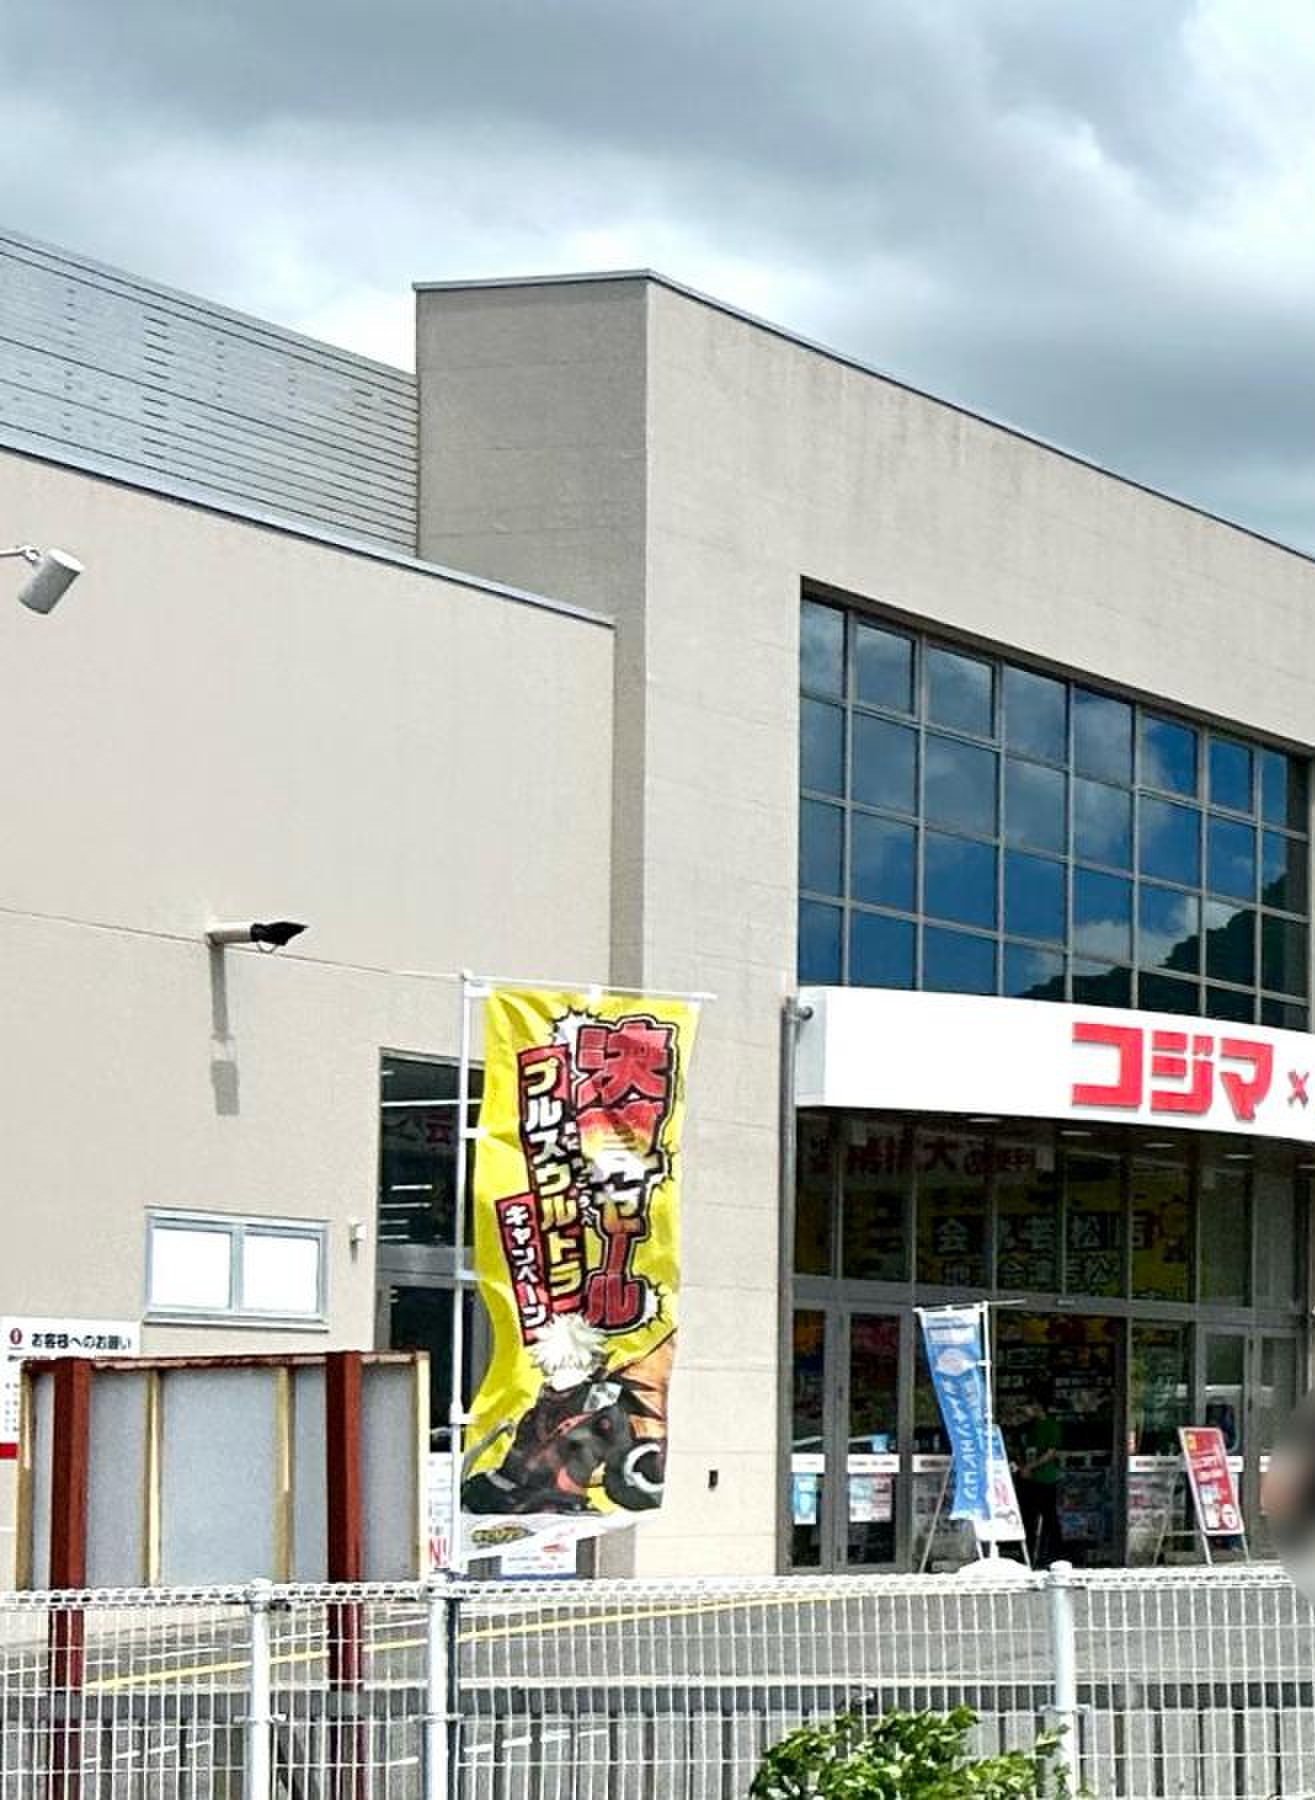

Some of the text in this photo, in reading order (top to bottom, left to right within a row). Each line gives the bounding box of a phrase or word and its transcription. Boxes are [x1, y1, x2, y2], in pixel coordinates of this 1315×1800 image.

[505, 1203, 548, 1328] キャンペーン
[523, 1058, 582, 1297] プルスウルトラ
